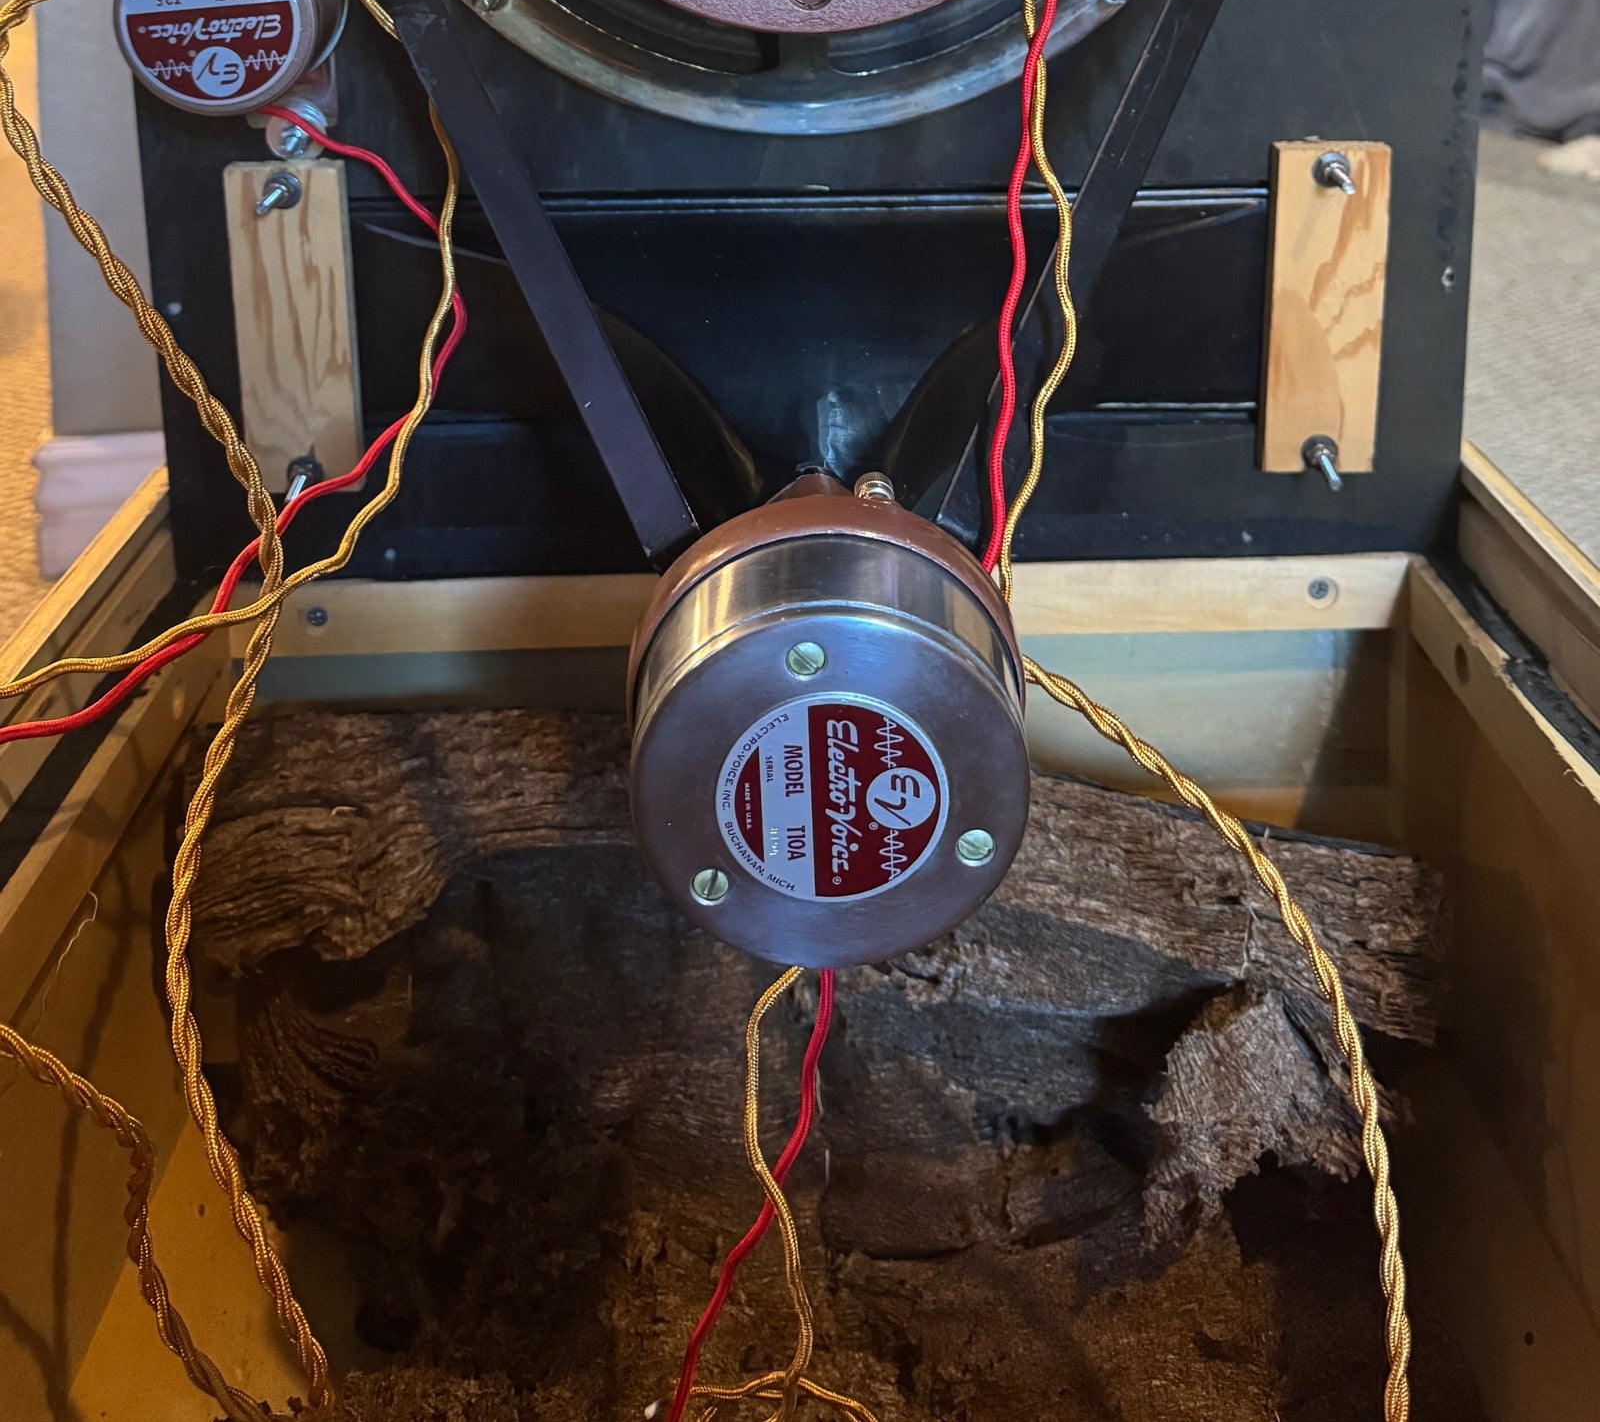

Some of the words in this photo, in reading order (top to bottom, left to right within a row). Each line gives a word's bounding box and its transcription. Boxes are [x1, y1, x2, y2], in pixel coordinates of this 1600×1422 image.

[196, 52, 239, 85] EV
[765, 756, 774, 783] SERIAL
[783, 745, 803, 798] MODEL
[722, 790, 732, 811] INC.
[874, 773, 920, 826] EV
[724, 821, 764, 877] BUCHANAN,
[786, 825, 806, 861] T10A
